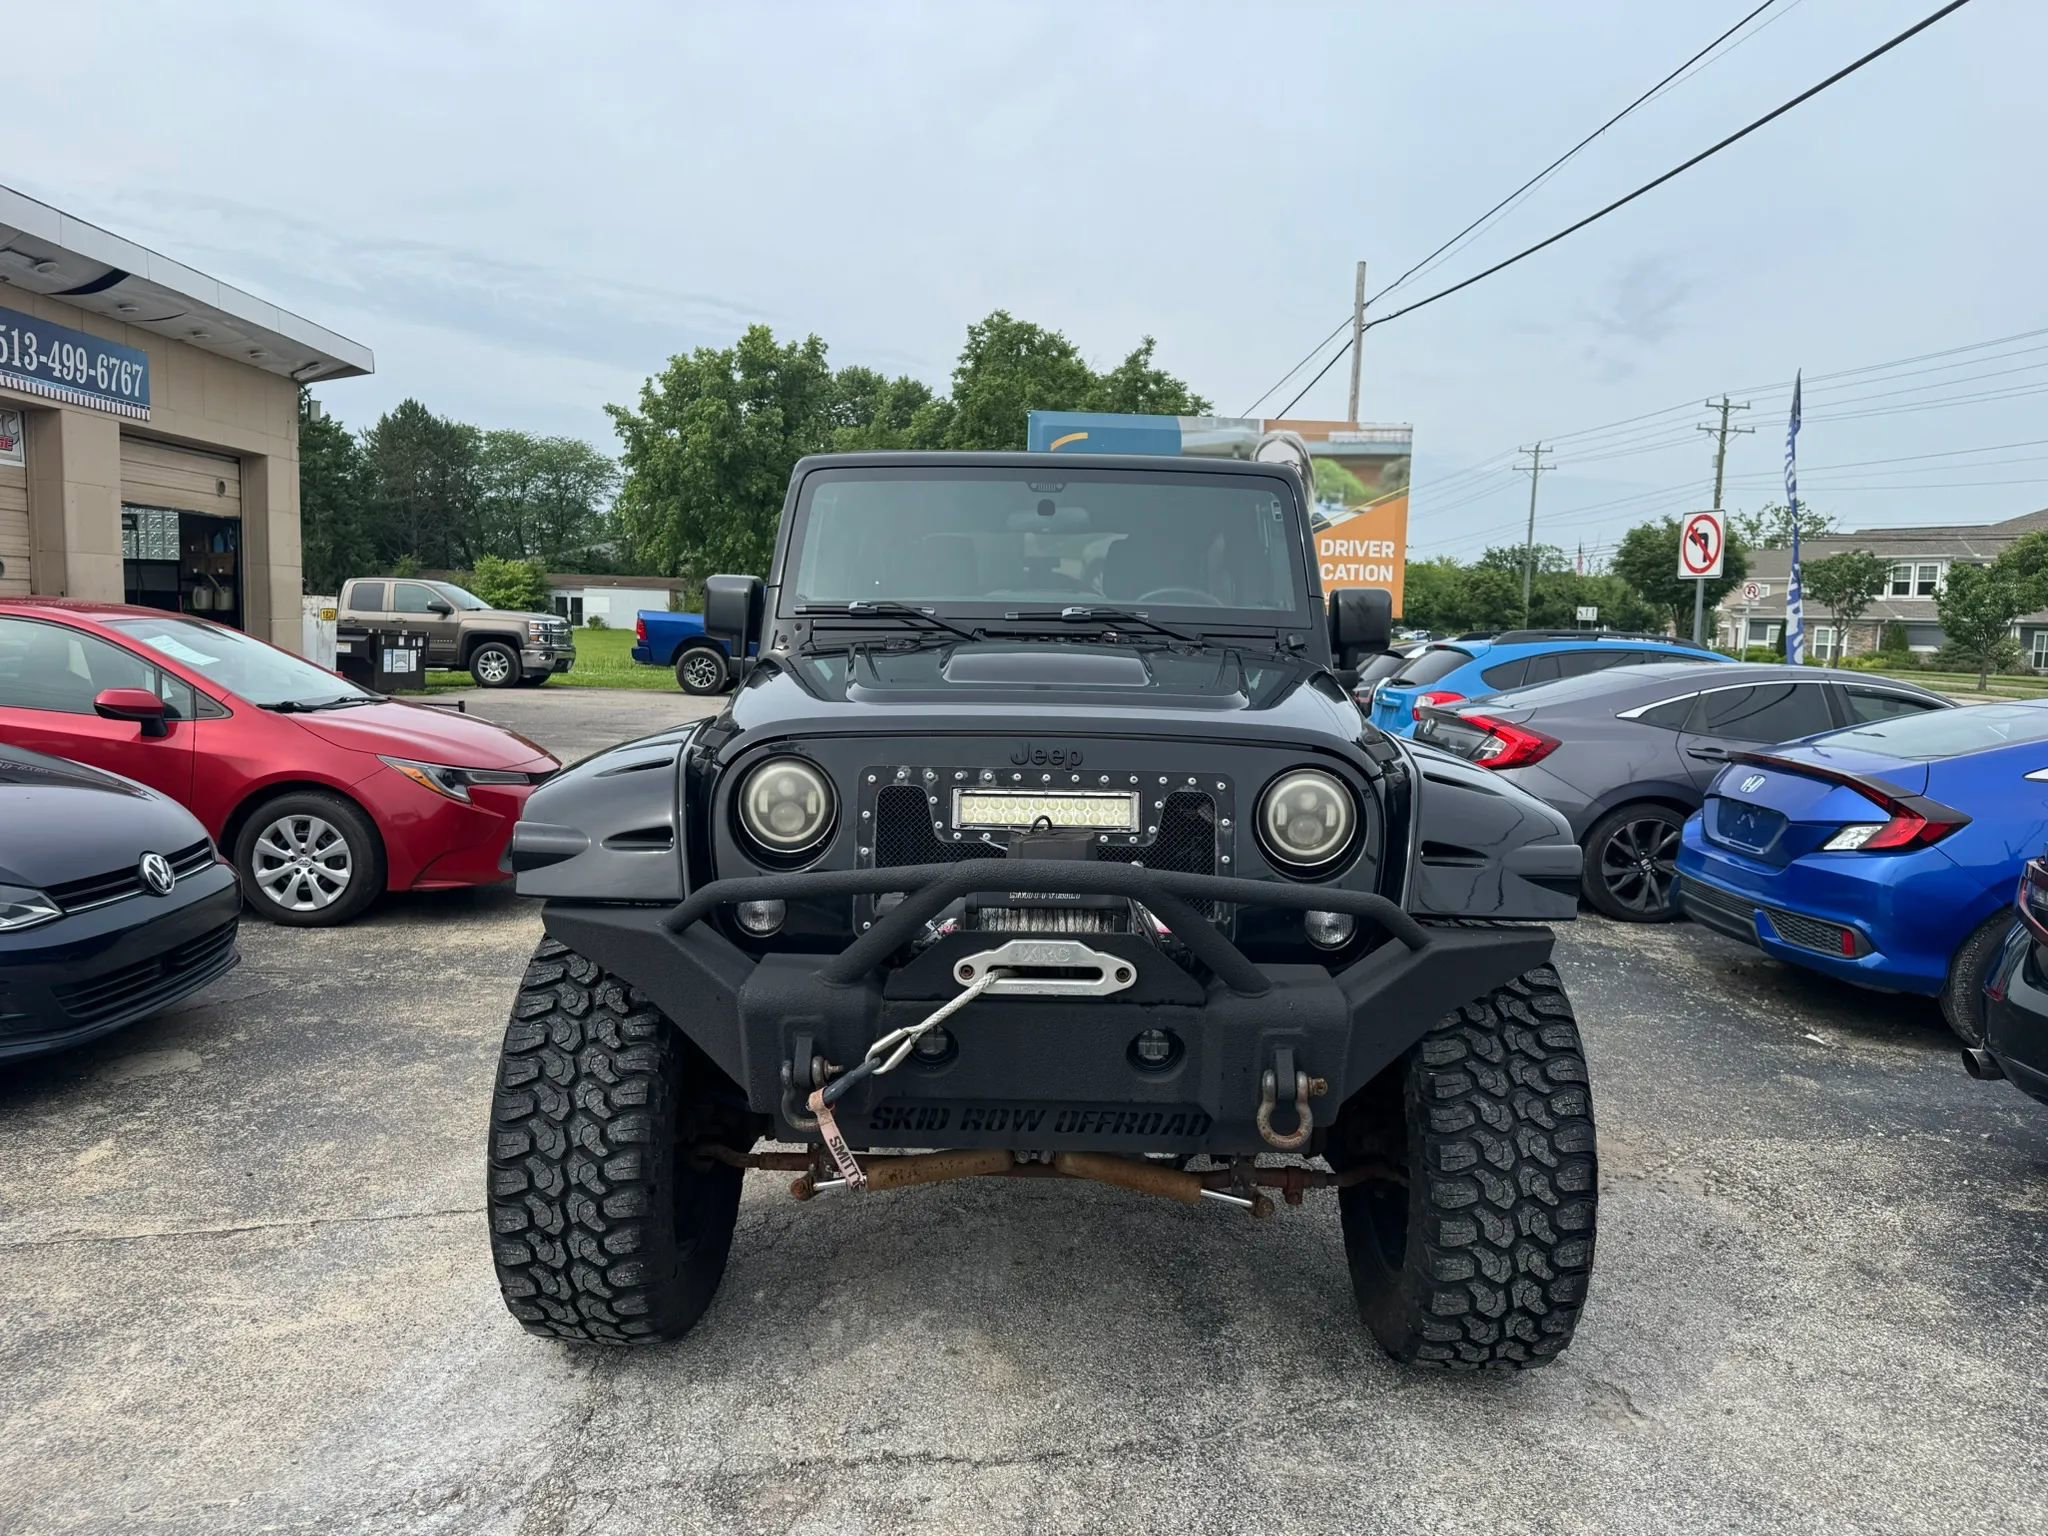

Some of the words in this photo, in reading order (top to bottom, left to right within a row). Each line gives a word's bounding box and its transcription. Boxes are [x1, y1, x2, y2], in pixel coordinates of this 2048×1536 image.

[0, 325, 143, 397] 513-499-6767
[1321, 539, 1394, 558] DRIVER
[1320, 563, 1393, 582] CATION
[1010, 742, 1083, 771] Jeep
[869, 1106, 950, 1131] SKID
[960, 1107, 1047, 1132] ROW
[1054, 1109, 1214, 1137] OFFROAD
